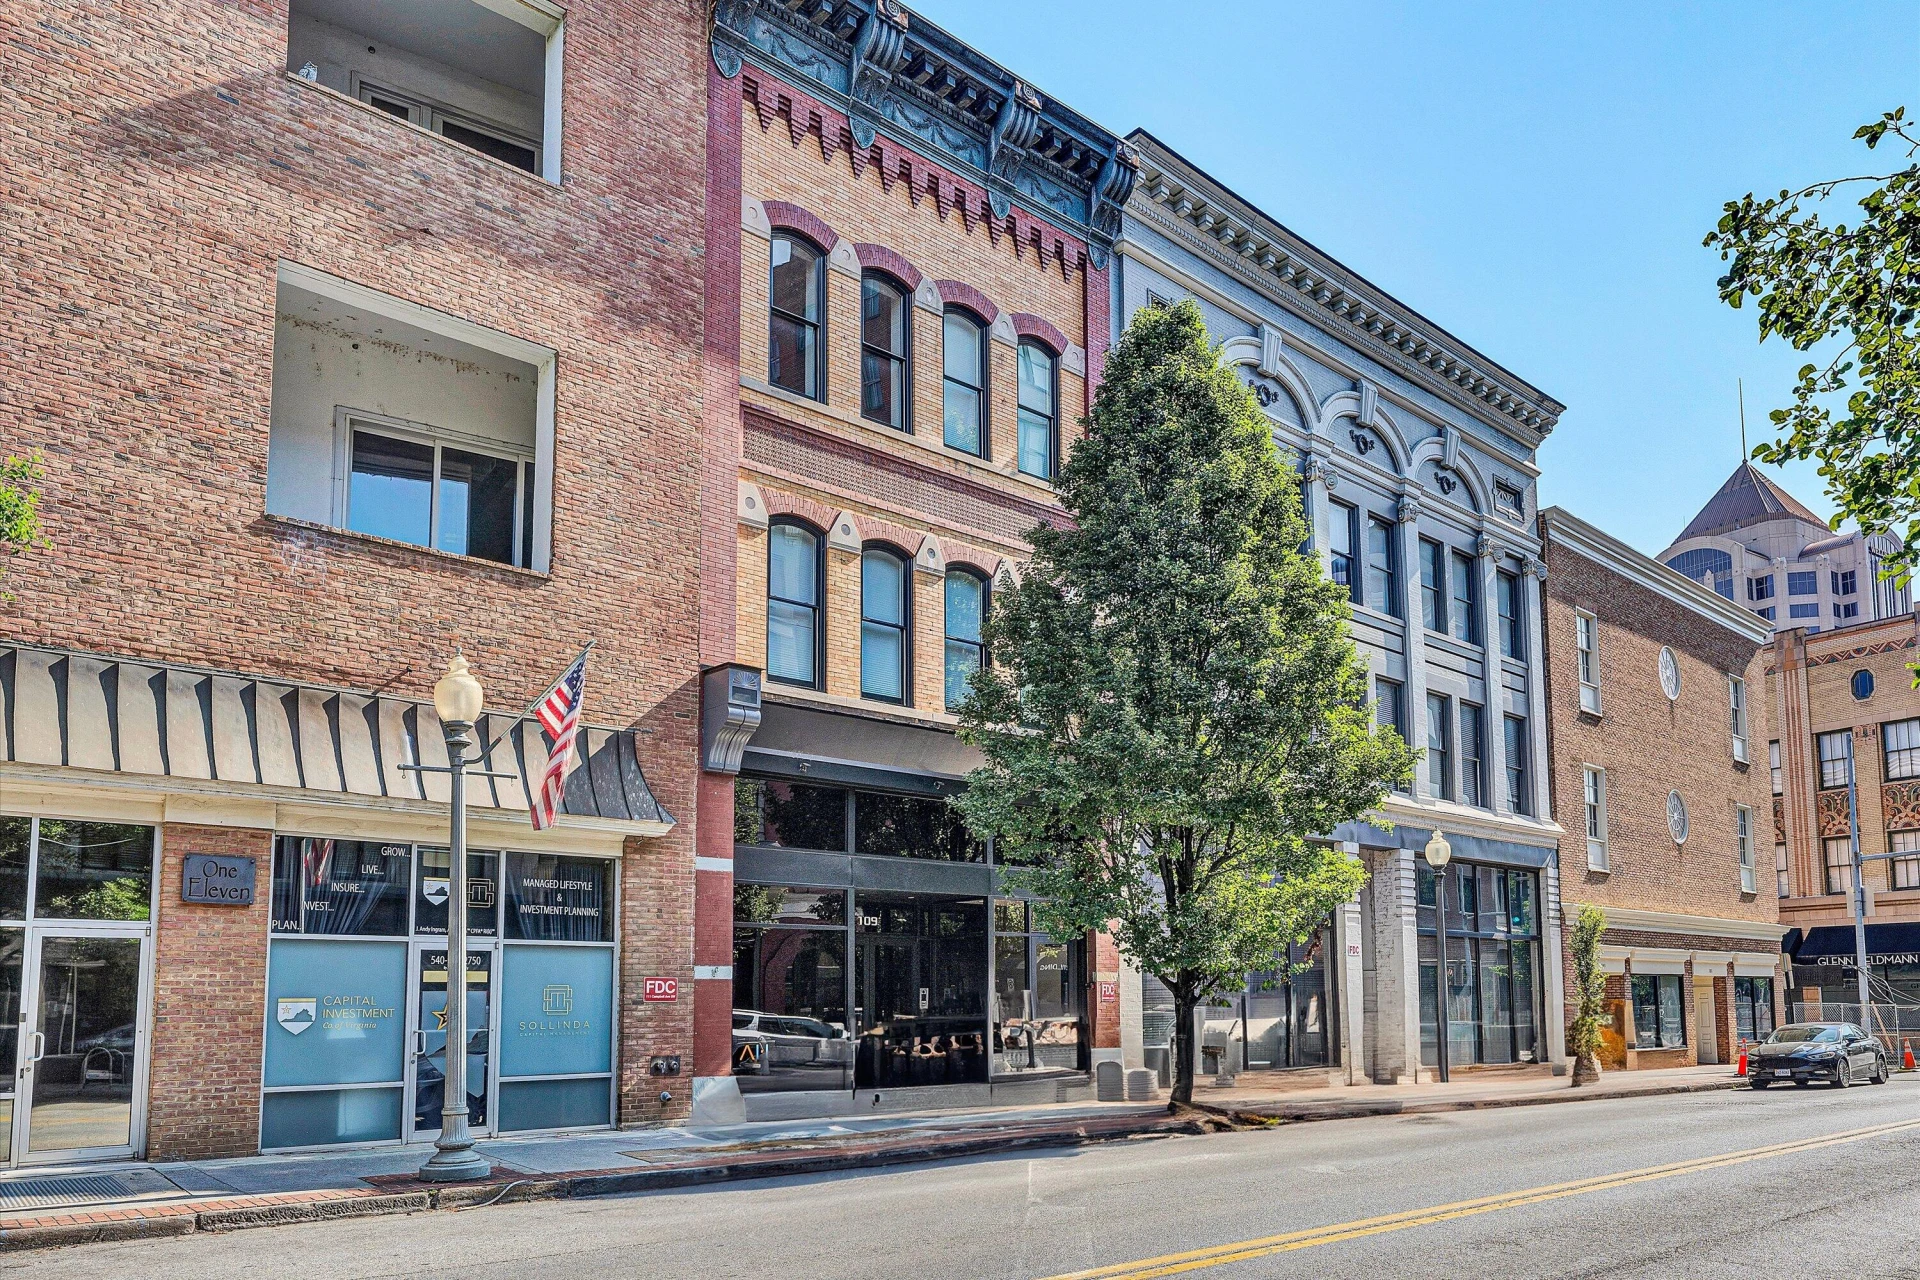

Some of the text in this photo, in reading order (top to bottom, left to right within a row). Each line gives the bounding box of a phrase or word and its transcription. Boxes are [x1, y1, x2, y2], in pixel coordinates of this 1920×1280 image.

[381, 847, 411, 858] GROW...
[203, 860, 238, 878] One
[361, 864, 385, 875] LIVE...
[188, 877, 250, 899] Eleven
[331, 882, 365, 893] INSURE...
[523, 878, 593, 891] MANAGED LIFESTYLE
[556, 893, 563, 902] &
[520, 904, 599, 917] INVESTMENT PLANNING
[857, 916, 878, 926] 109
[1349, 945, 1360, 955] FDC
[1817, 954, 1919, 966] GLENN ELDMANN
[646, 980, 676, 994] FDC
[1102, 984, 1115, 995] FDC
[323, 996, 377, 1006] CAPITAL
[322, 1008, 395, 1019] INVESTMENT
[334, 1021, 344, 1031] of
[345, 1021, 377, 1031] Virginia
[519, 1020, 590, 1031] SOLLINDA
